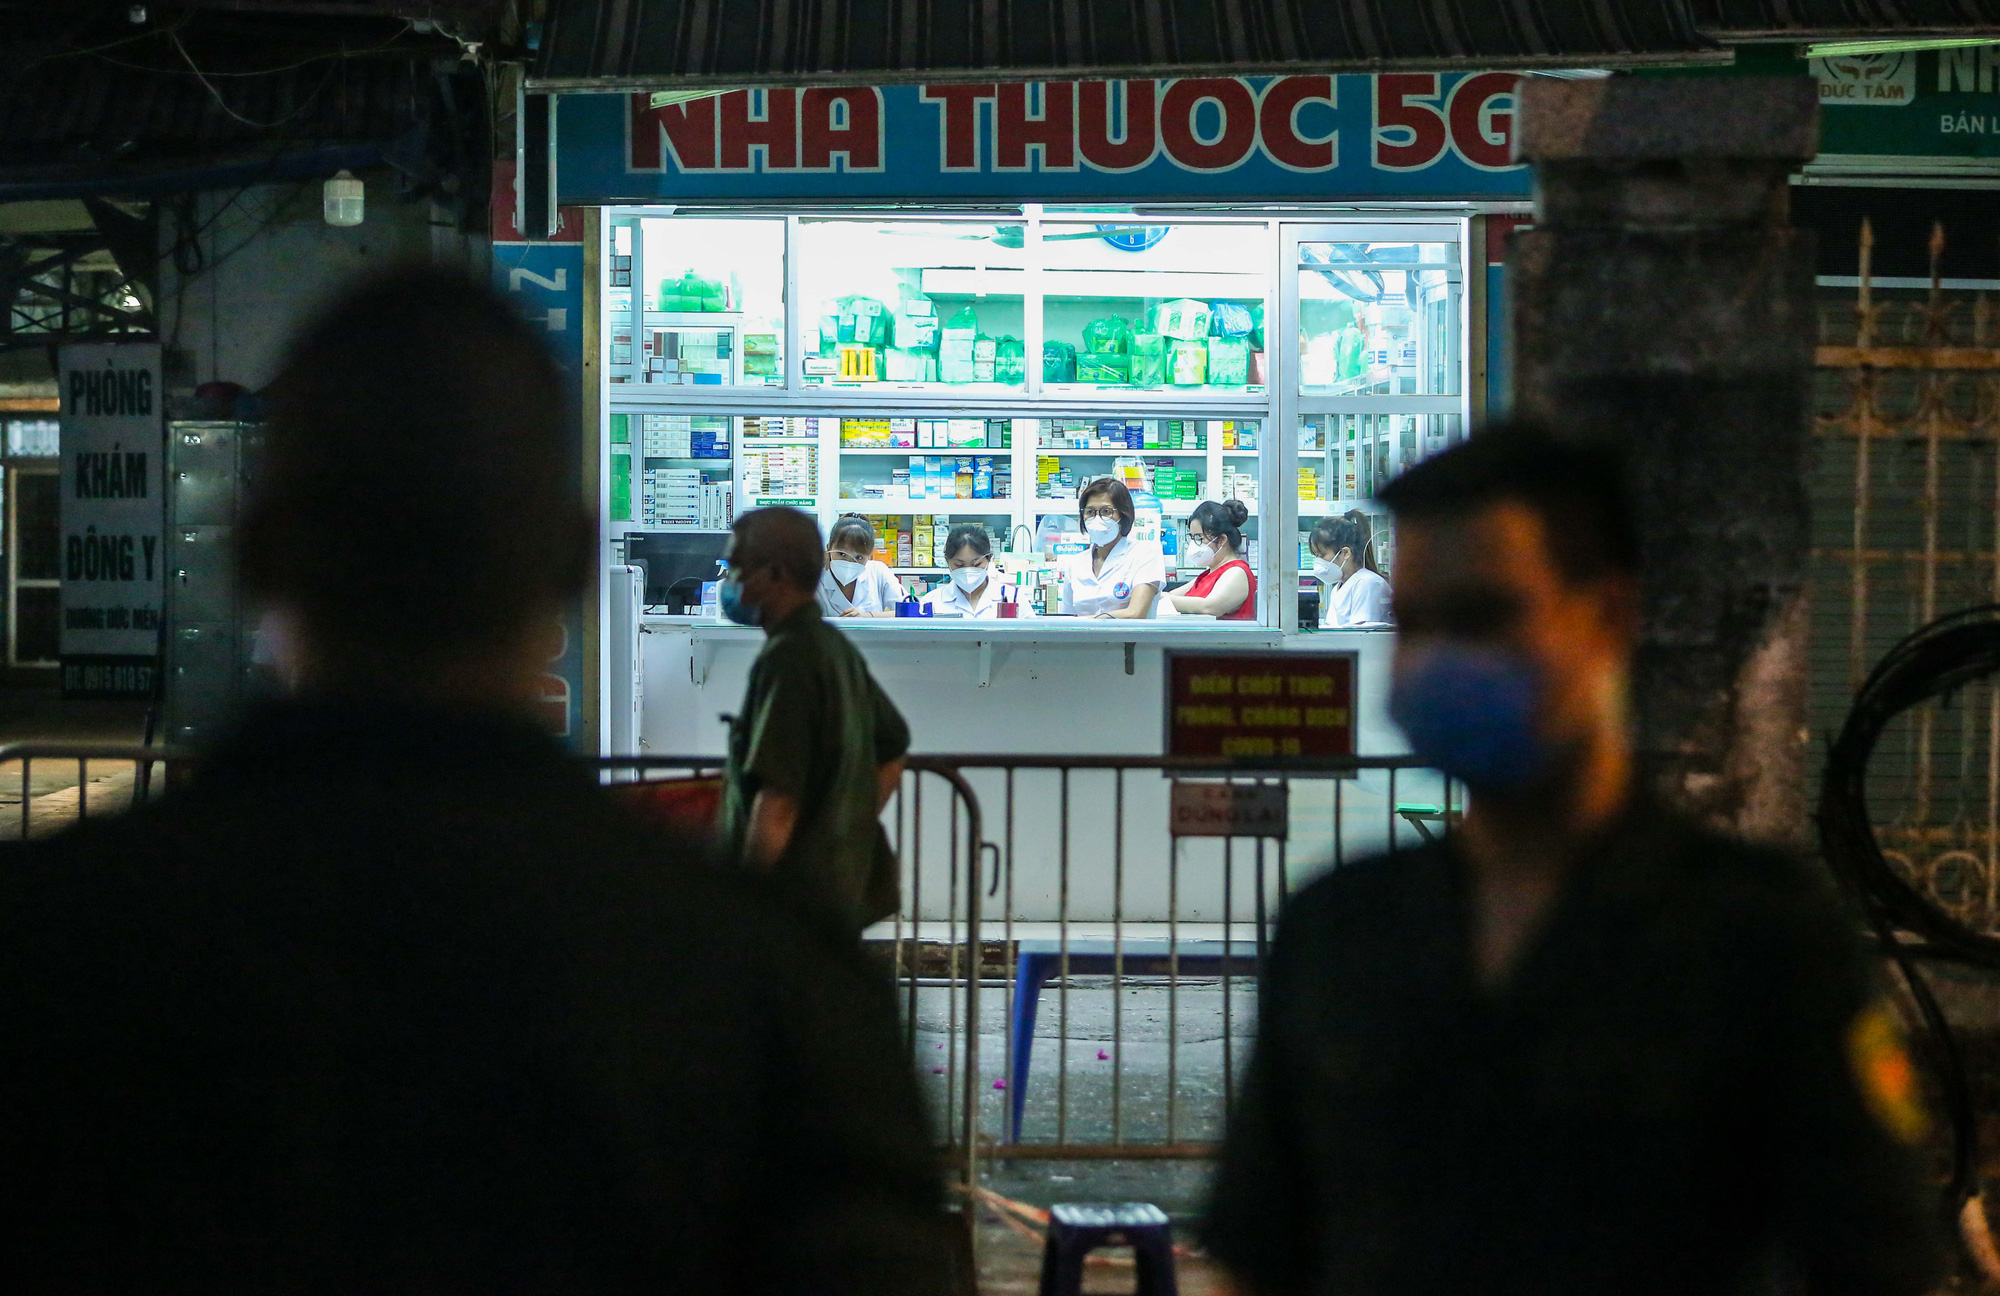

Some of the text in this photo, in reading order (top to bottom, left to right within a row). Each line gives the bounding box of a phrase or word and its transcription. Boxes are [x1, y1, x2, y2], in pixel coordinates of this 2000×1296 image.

[1940, 110, 1985, 134] BÁN
[68, 358, 153, 417] PHÒNG
[75, 442, 148, 499] KHÁM
[66, 525, 157, 582] ĐÔNG Y
